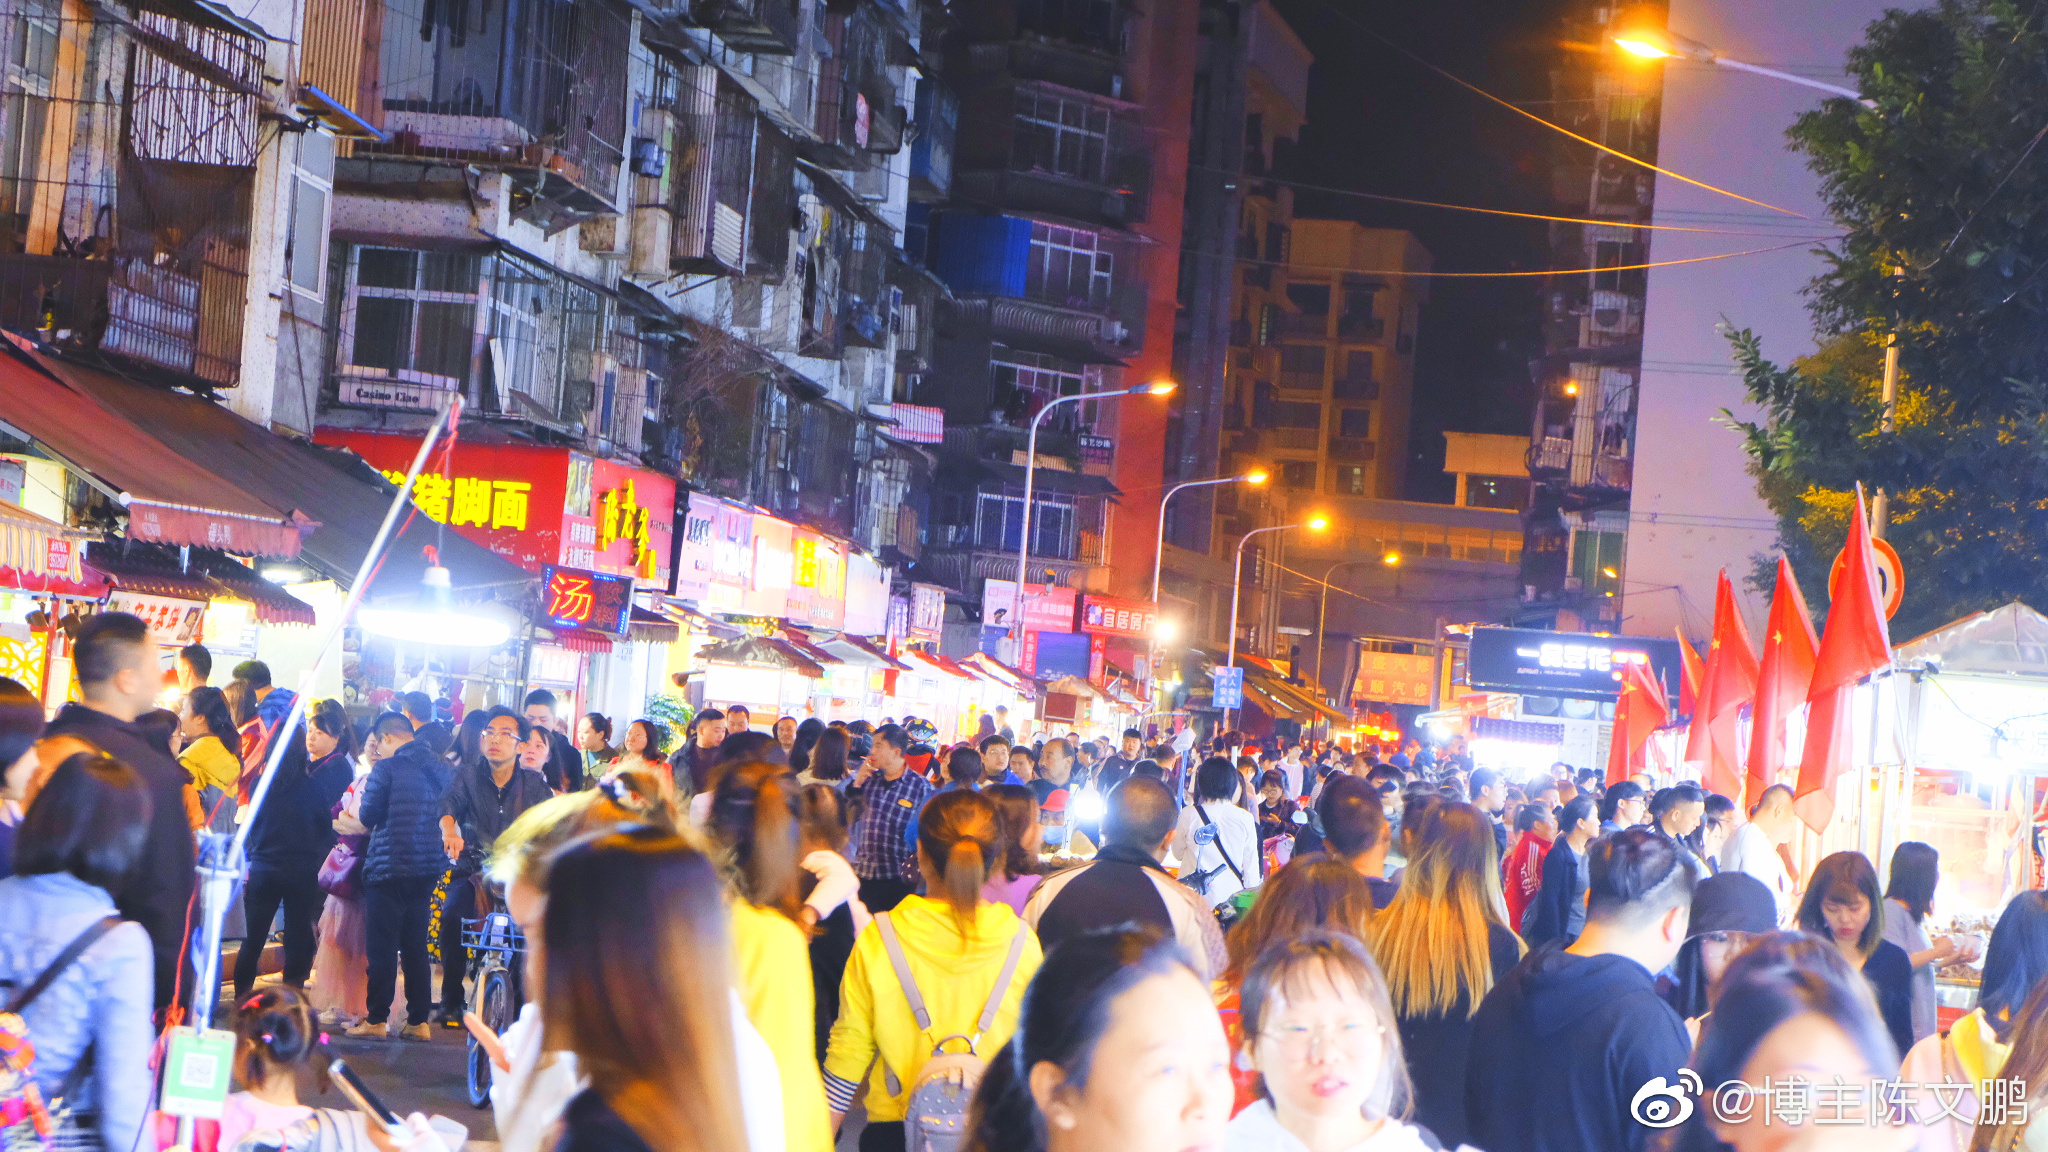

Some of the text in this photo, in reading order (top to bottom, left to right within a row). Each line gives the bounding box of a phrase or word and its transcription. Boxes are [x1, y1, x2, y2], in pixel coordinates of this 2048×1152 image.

[356, 388, 391, 401] Casino
[382, 470, 532, 531] 猪脚面
[548, 573, 594, 622] 汤
[594, 580, 625, 630] 饮料
[1103, 608, 1158, 632] 宜居房产
[1516, 643, 1612, 672] 一品豆花
